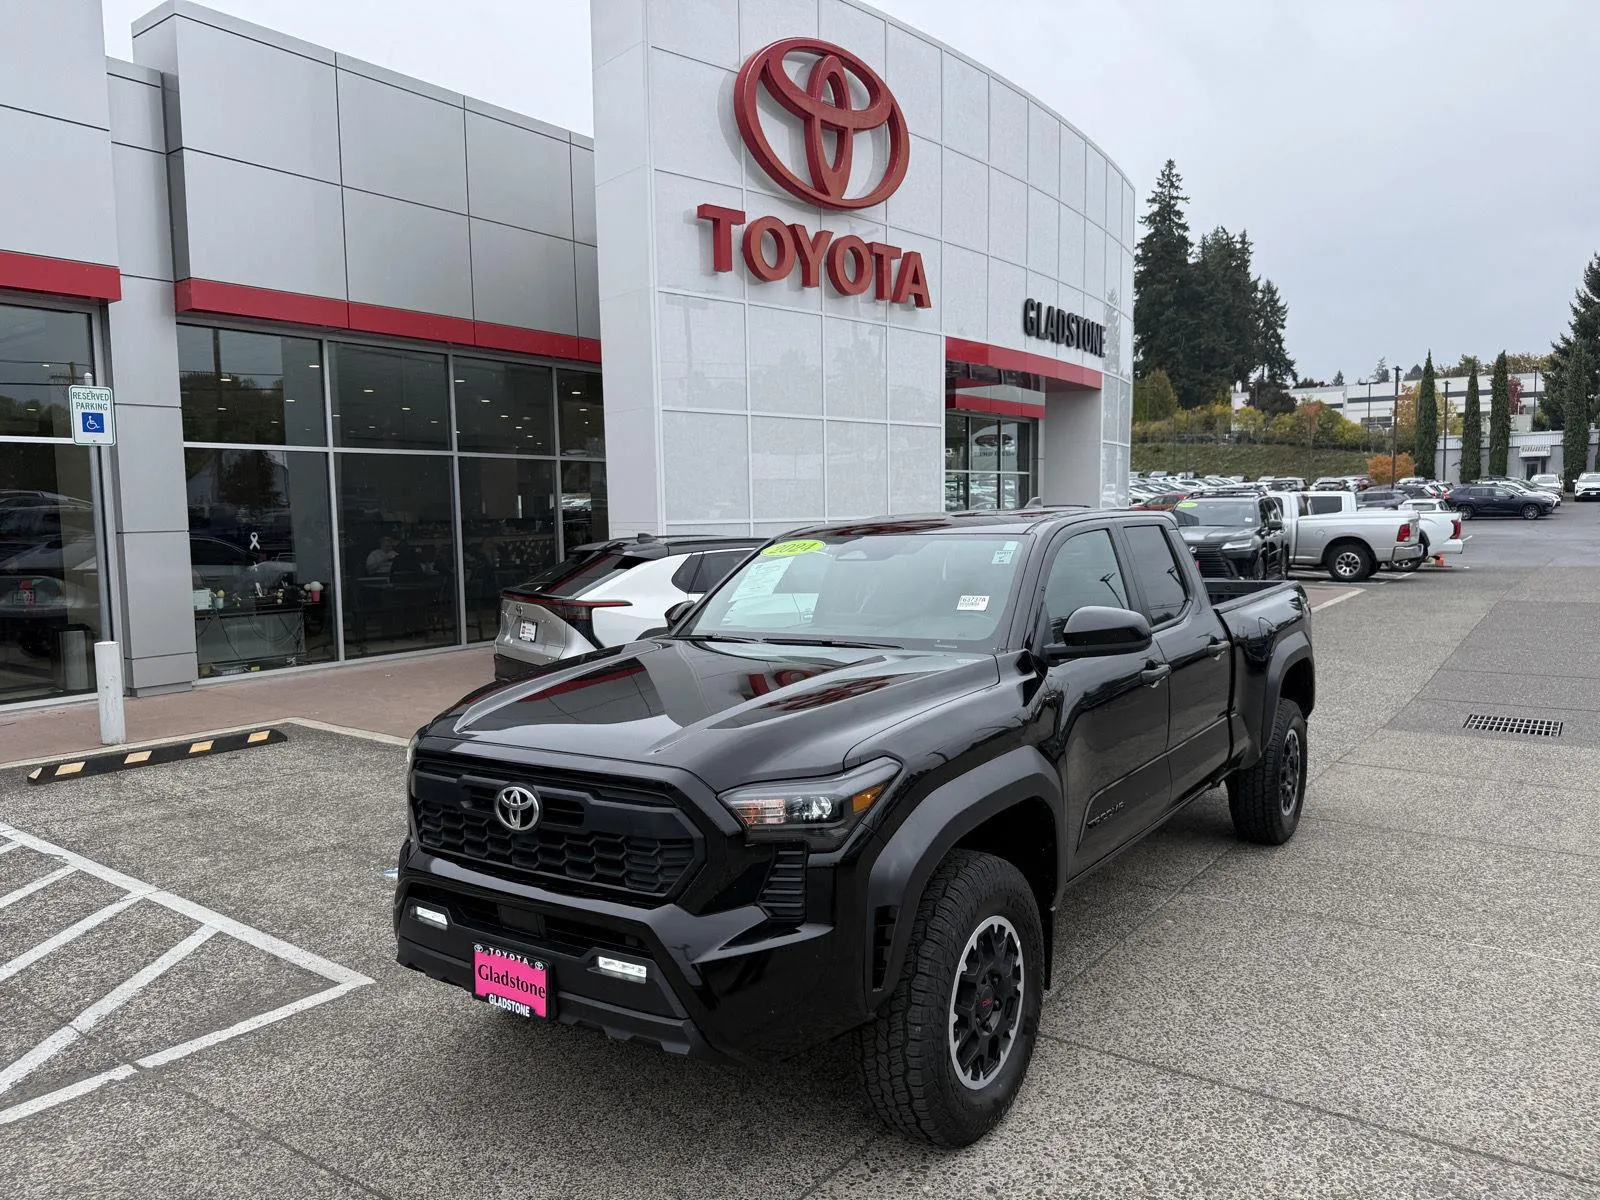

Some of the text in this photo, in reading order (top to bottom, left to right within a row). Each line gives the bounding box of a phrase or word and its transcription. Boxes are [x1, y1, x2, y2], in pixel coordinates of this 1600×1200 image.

[697, 203, 932, 309] TOYOTA
[1023, 297, 1106, 358] GLADSTONE
[72, 391, 110, 401] RESERVED
[75, 401, 108, 411] PARKING
[488, 947, 529, 965] TOYOTA
[477, 964, 546, 999] Gladstone
[488, 993, 531, 1017] GLADSTONE
